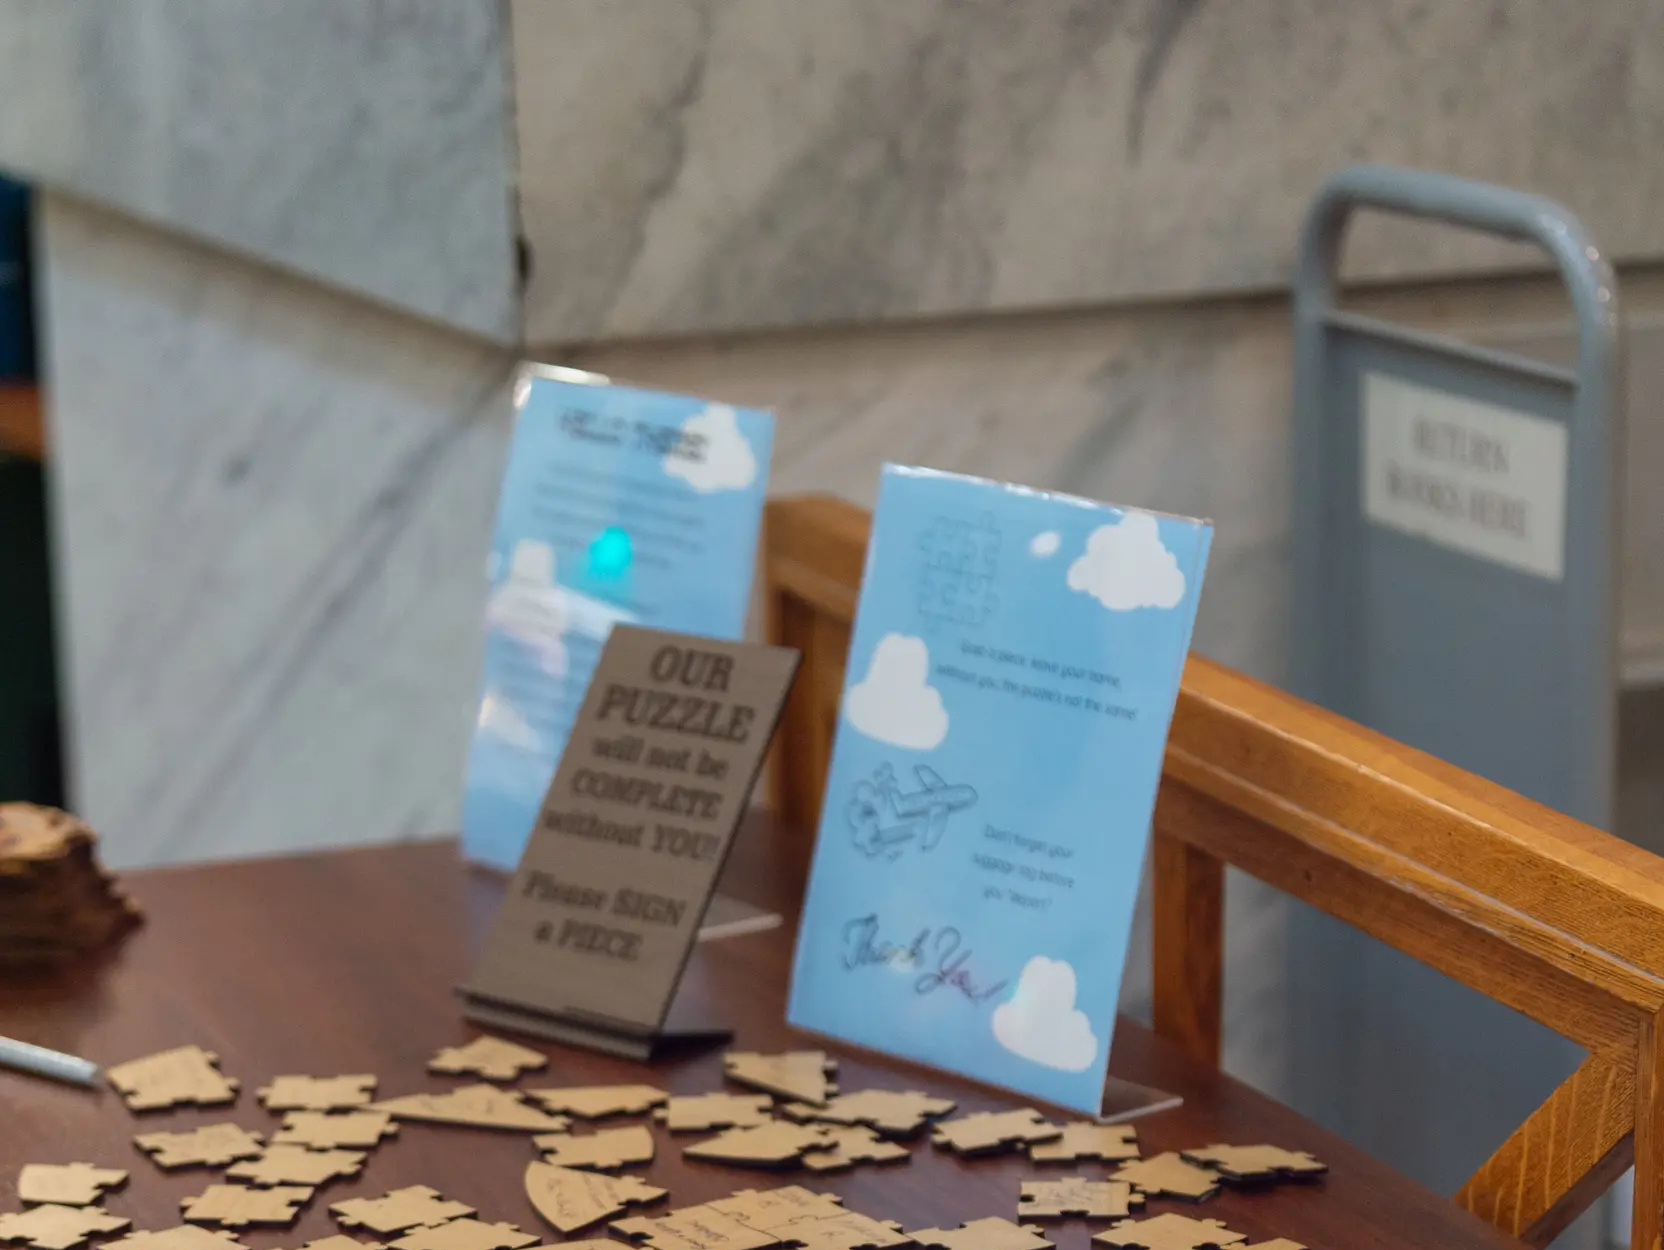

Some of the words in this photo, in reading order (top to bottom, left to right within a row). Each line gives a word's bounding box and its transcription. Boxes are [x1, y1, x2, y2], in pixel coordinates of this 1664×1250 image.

[650, 645, 736, 692] OUR
[596, 684, 756, 744] PUZZLE
[592, 735, 642, 766] will
[645, 745, 691, 774] not
[695, 750, 728, 782] be
[570, 768, 726, 822] COMPLETE
[542, 808, 645, 848] without
[523, 870, 609, 909] Please
[611, 888, 687, 929] SIGN
[534, 920, 552, 945] a
[557, 918, 644, 963] PIECE
